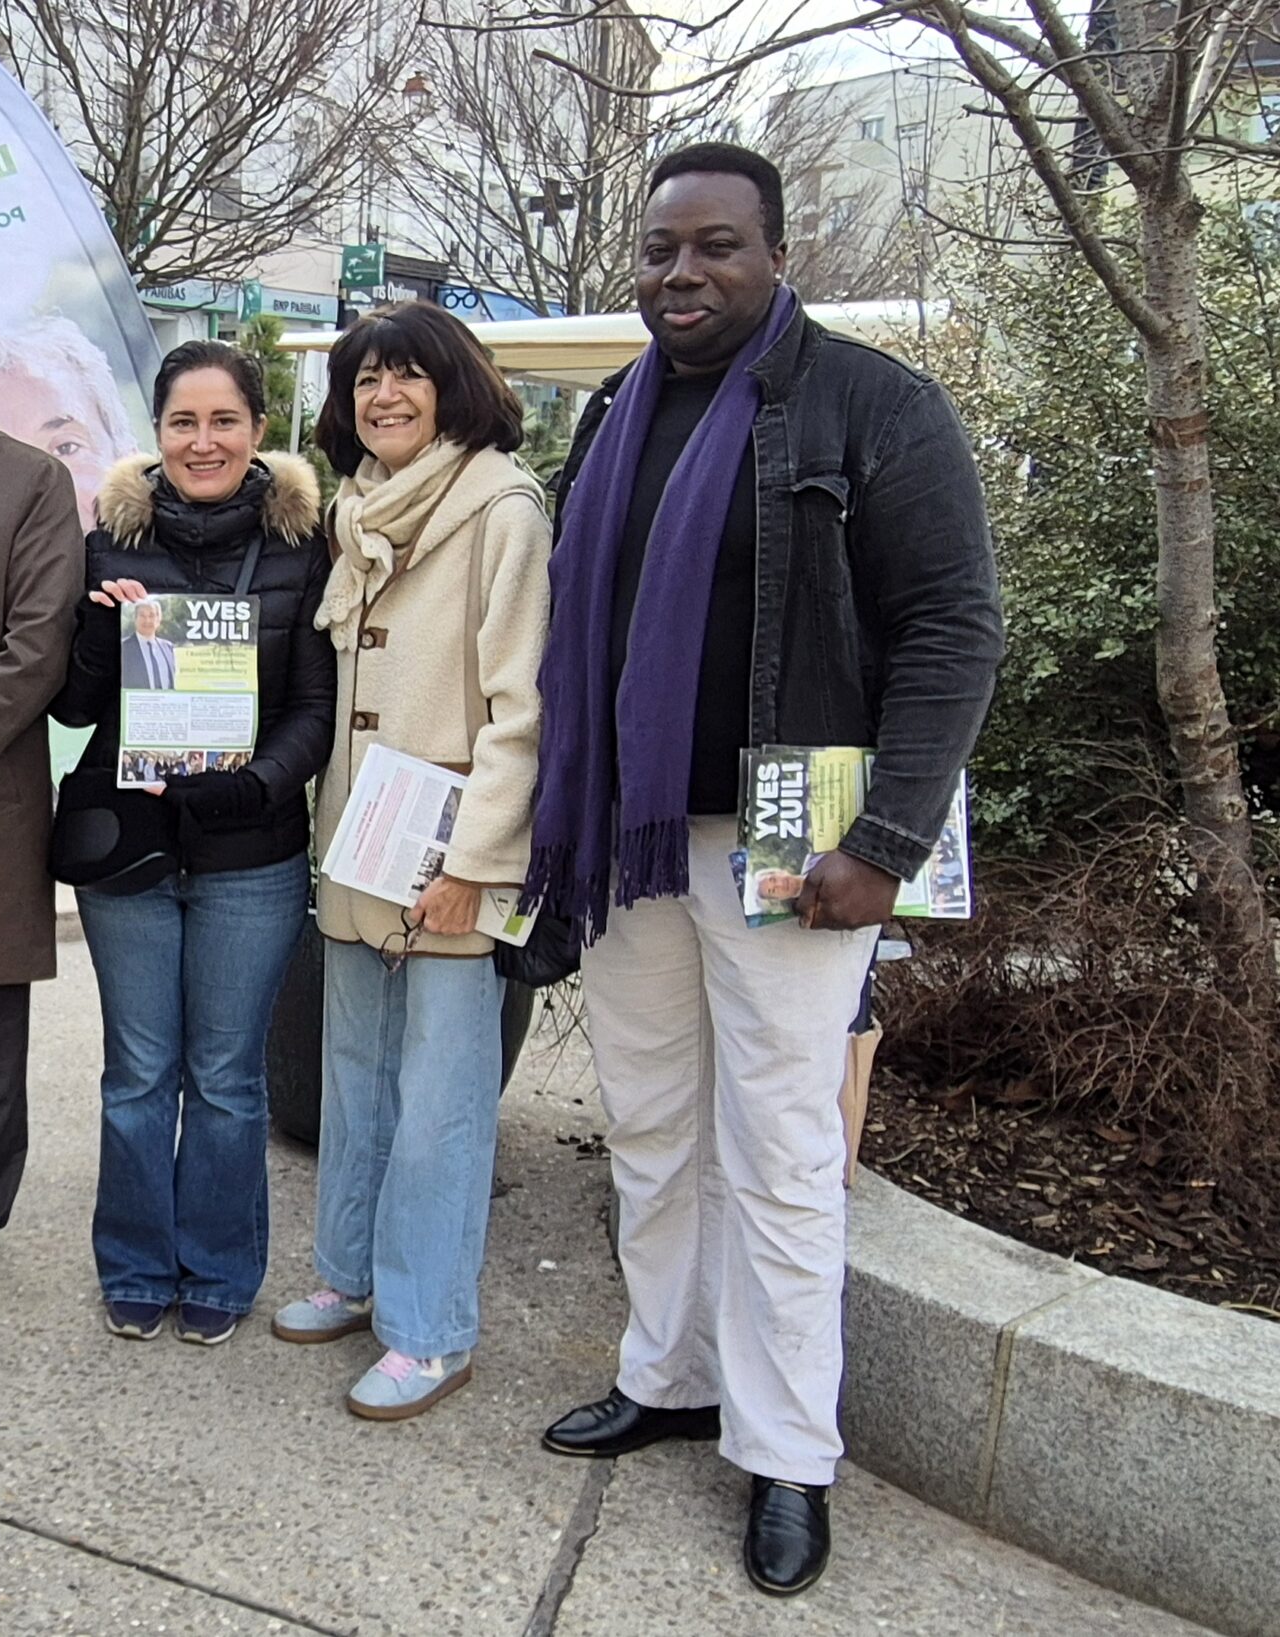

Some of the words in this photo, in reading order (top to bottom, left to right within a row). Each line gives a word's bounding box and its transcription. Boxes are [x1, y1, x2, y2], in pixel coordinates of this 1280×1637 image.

[186, 601, 251, 621] YVES
[186, 620, 250, 640] ZUILI
[755, 762, 780, 841] YVES
[779, 762, 804, 839] ZUILI
